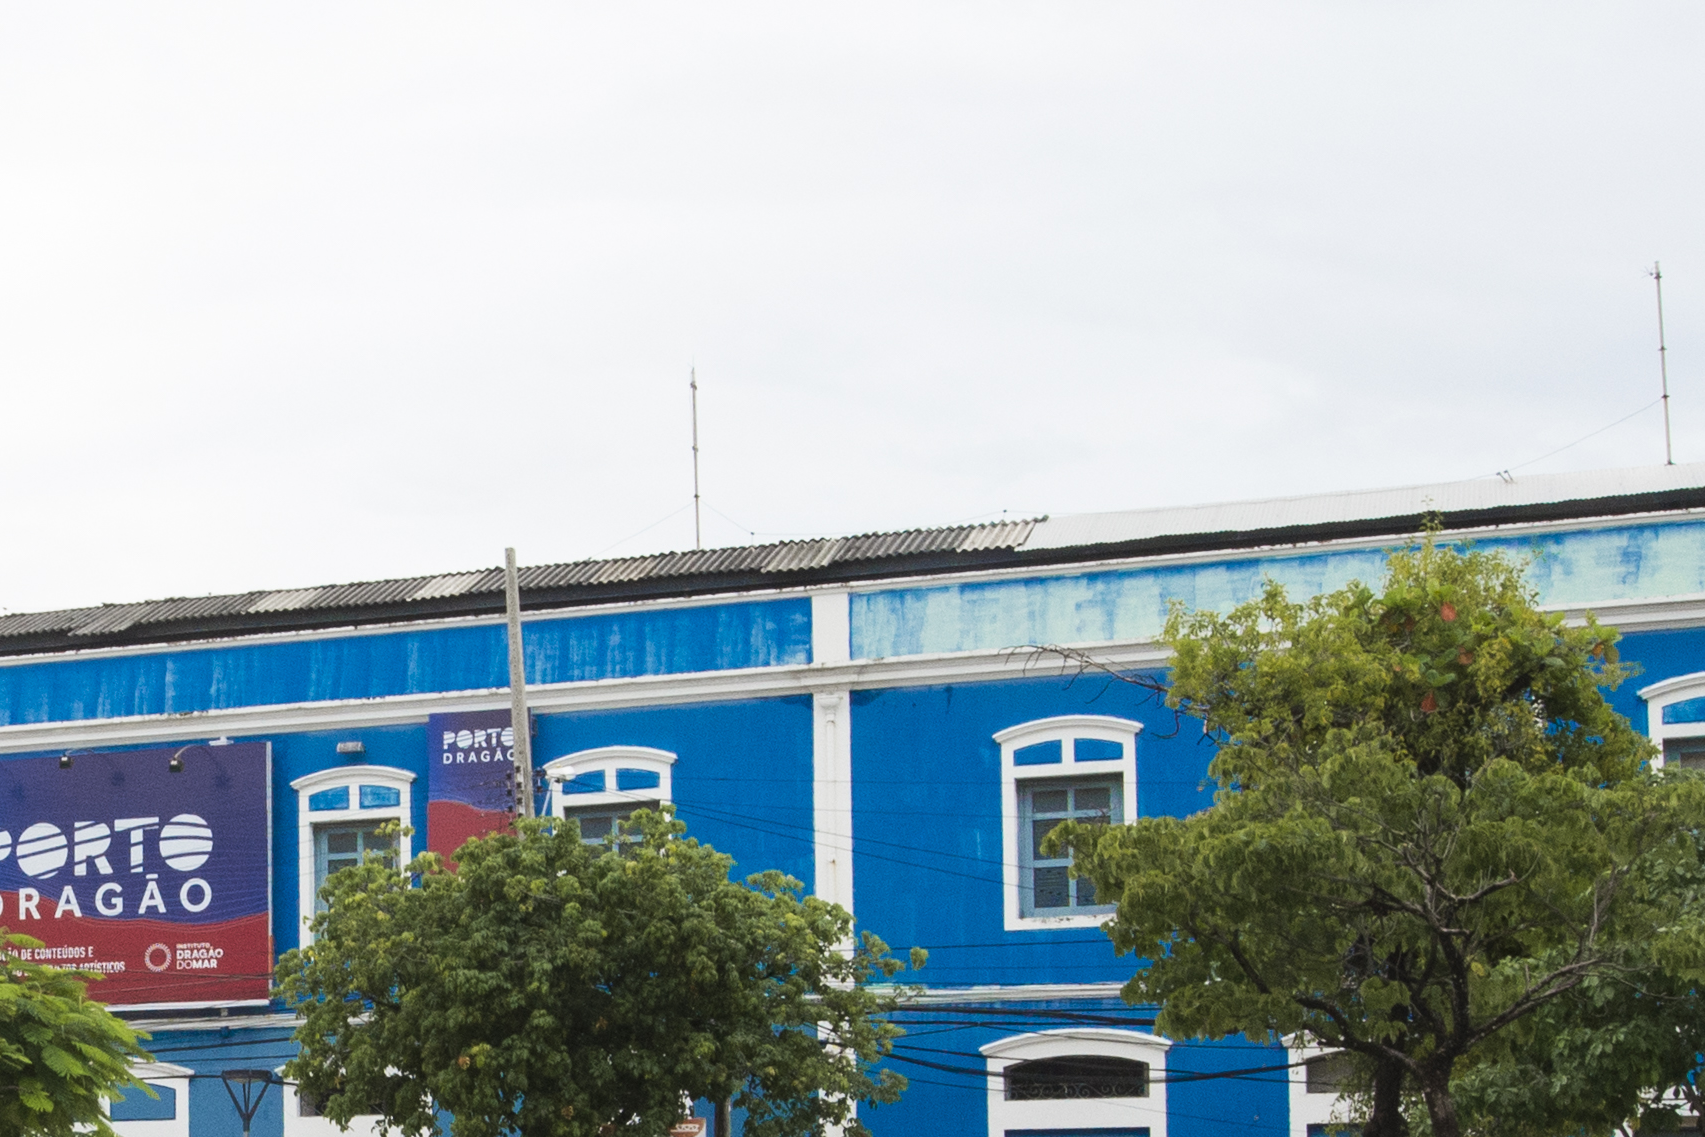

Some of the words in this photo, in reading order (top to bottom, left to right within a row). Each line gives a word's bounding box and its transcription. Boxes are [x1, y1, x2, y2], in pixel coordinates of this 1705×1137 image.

[21, 949, 32, 960] DE
[34, 945, 86, 960] CONTEÚDOS
[88, 946, 94, 957] E
[176, 946, 224, 959] DRAGÃO
